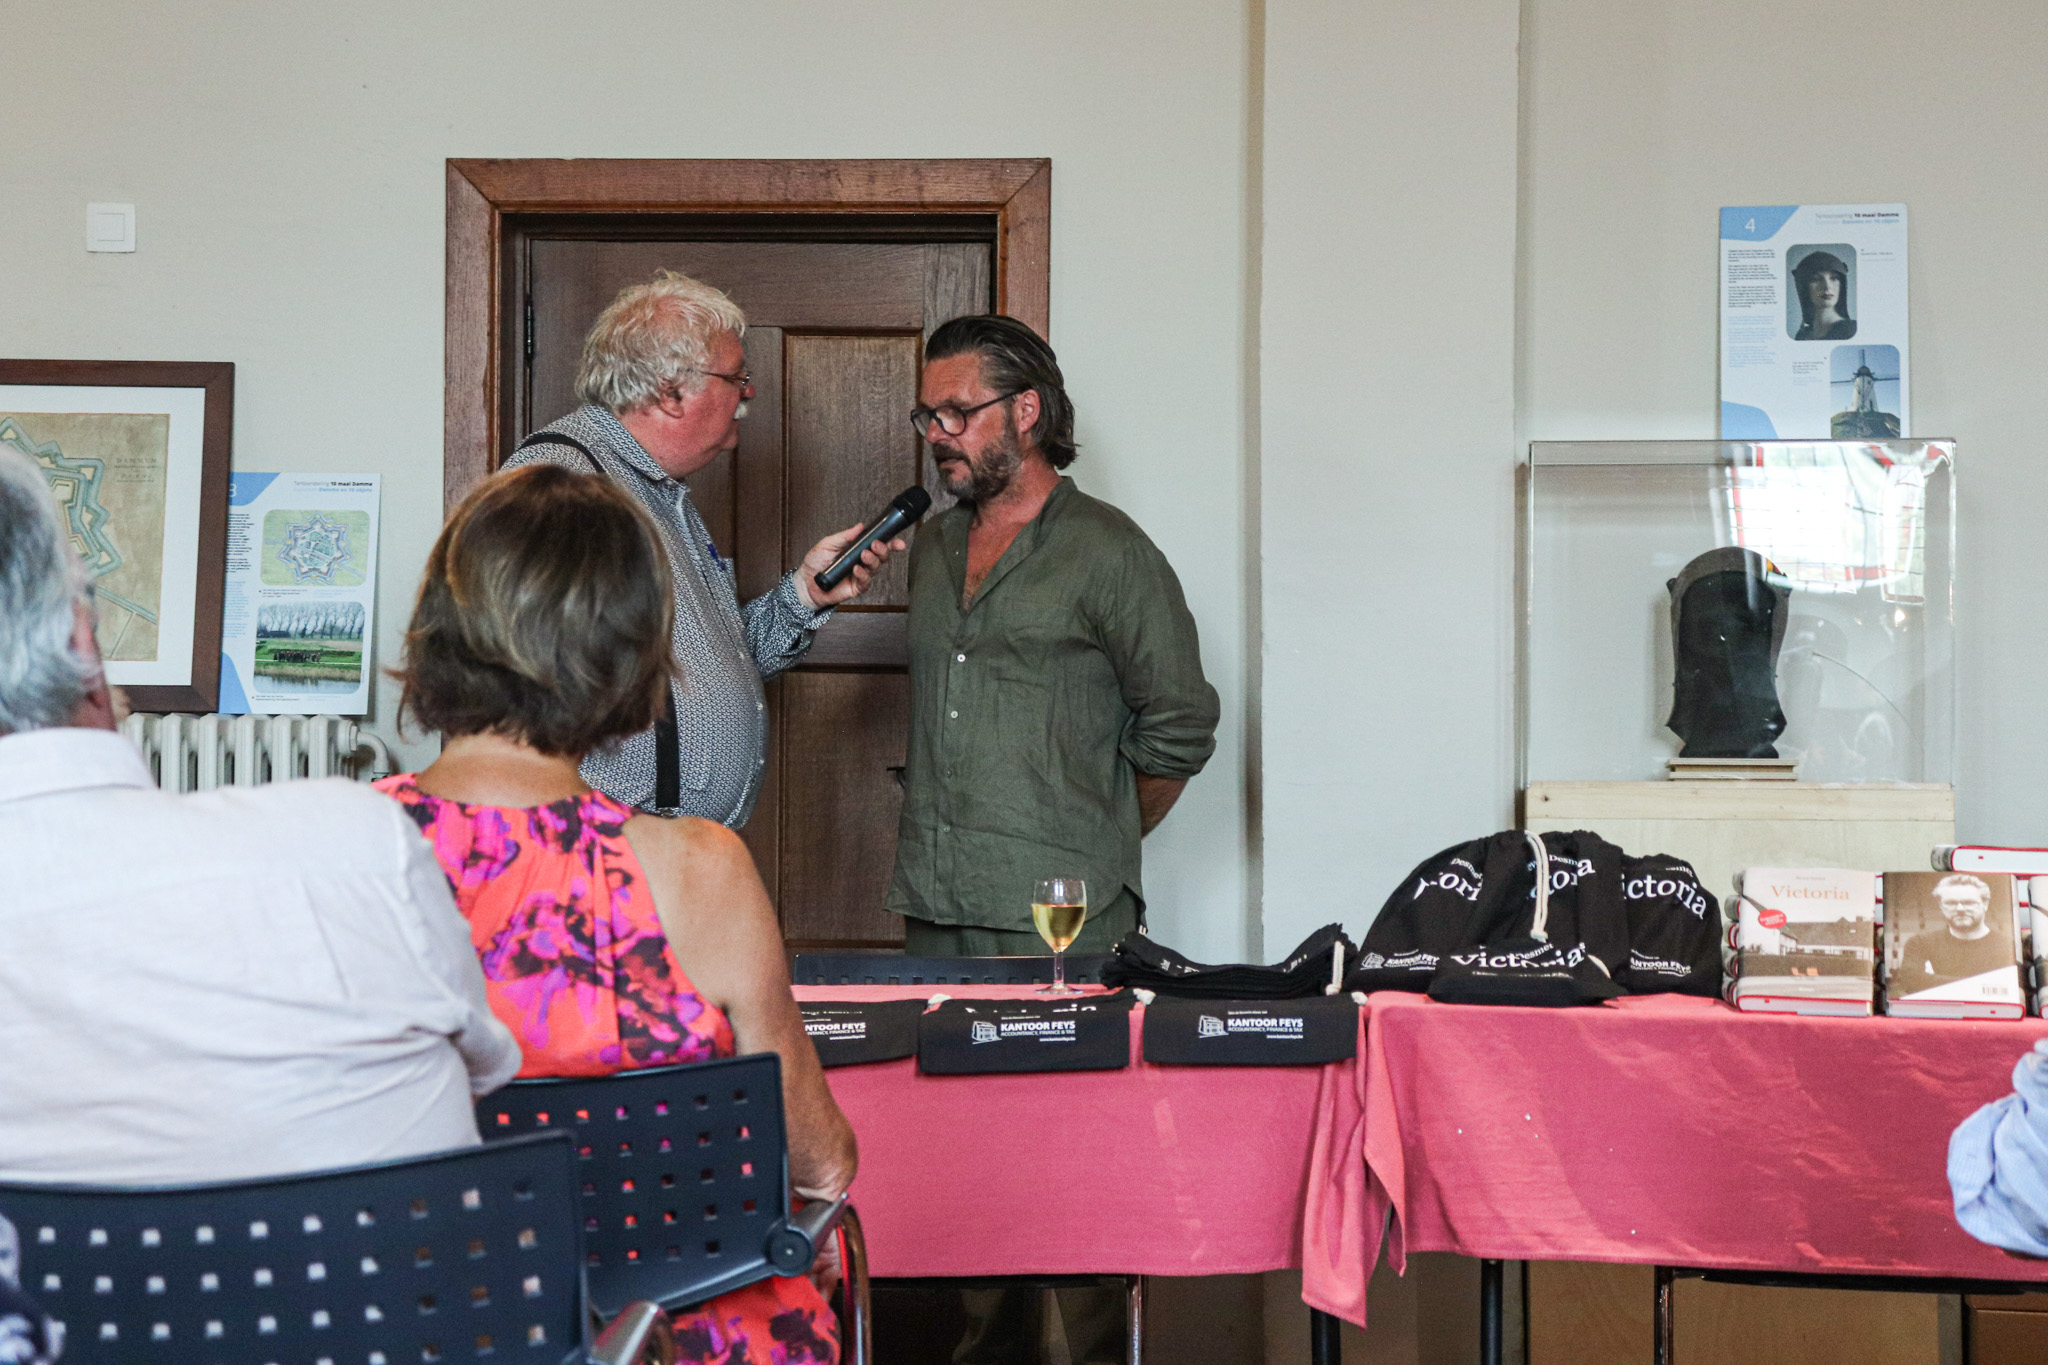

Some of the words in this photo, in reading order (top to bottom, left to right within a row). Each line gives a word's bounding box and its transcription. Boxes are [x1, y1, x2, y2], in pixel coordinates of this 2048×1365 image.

[1744, 217, 1756, 233] 4
[229, 483, 237, 497] 3
[1549, 854, 1579, 866] Desm
[1621, 874, 1707, 920] ictoria
[1771, 884, 1850, 900] Victoria
[804, 1024, 841, 1032] NTOOR
[841, 1022, 866, 1030] FEYS
[1000, 1022, 1050, 1032] KANTOOR
[1051, 1021, 1076, 1030] FEYS
[1227, 1018, 1278, 1028] KANTOOR
[1279, 1018, 1304, 1027] FEYS
